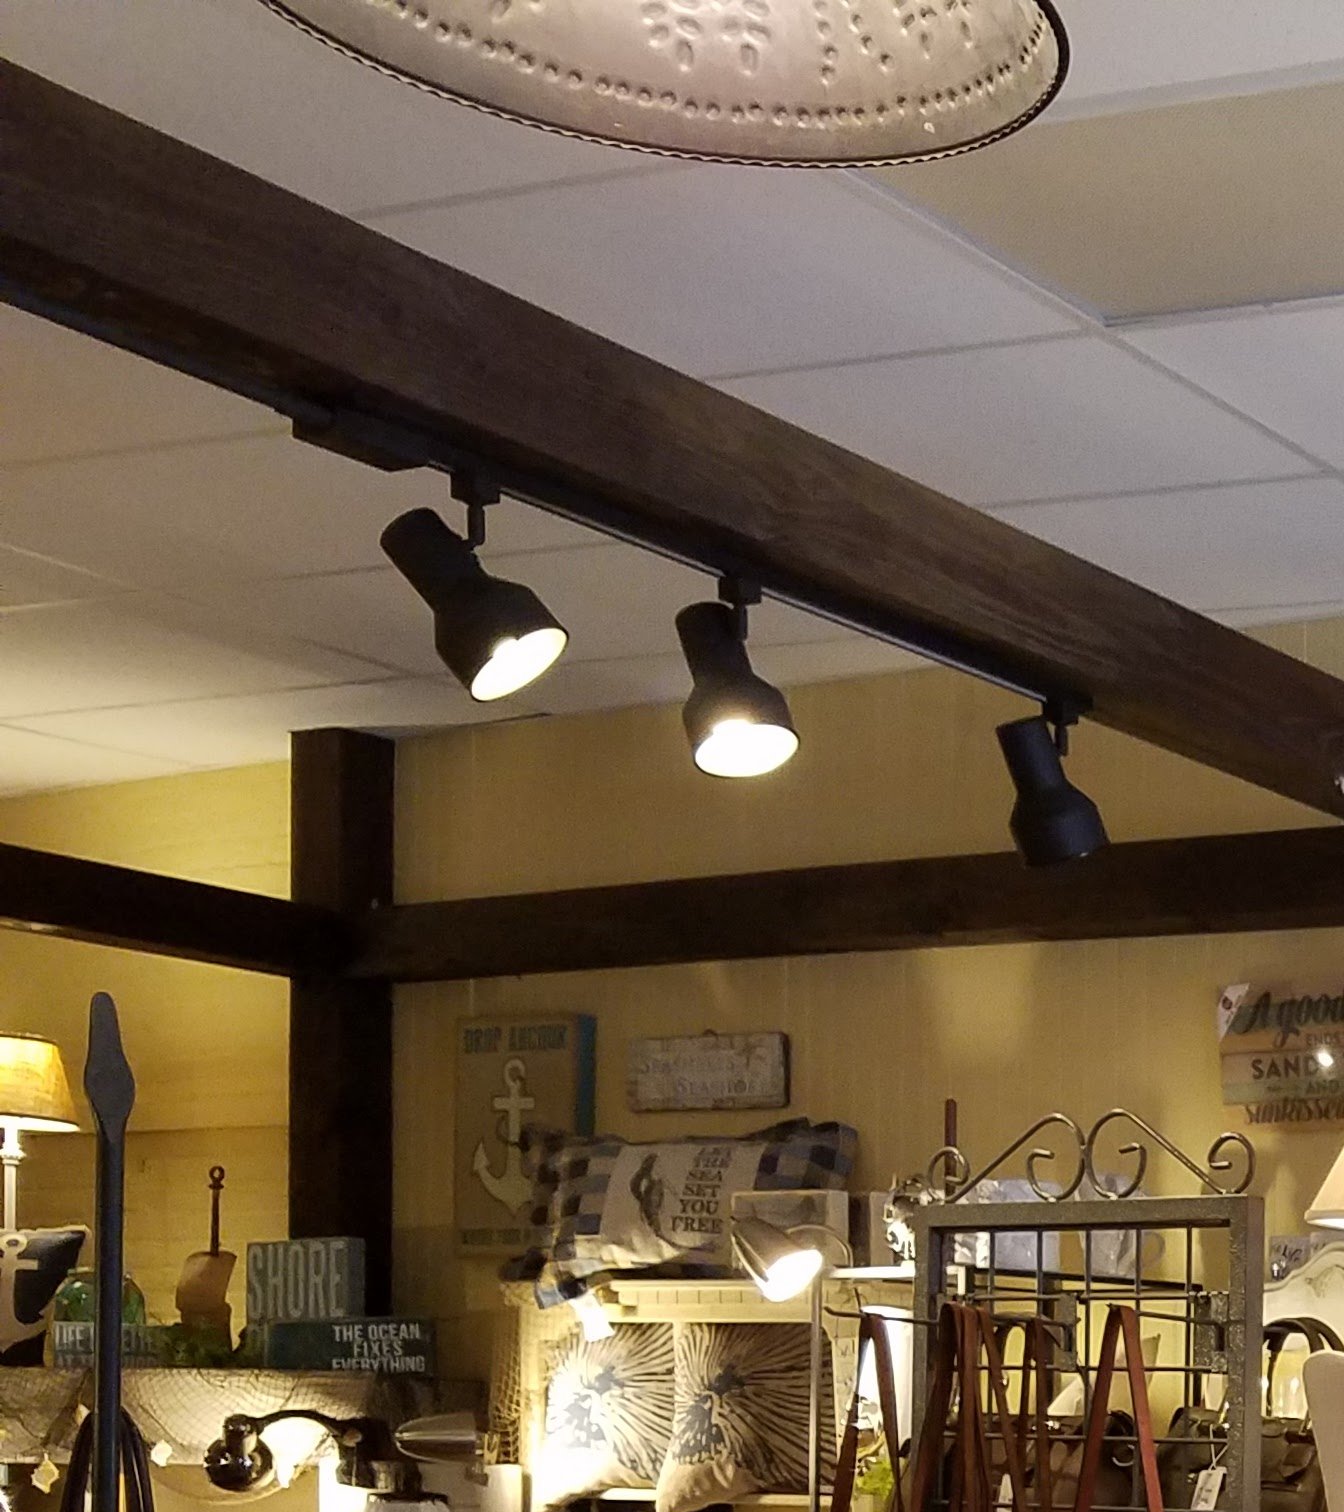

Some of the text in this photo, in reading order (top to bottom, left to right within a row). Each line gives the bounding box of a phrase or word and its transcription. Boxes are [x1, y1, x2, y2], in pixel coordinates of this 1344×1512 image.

[1252, 1050, 1331, 1080] SAND
[683, 1184, 721, 1197] SET
[680, 1199, 718, 1215] YOU
[671, 1216, 723, 1234] FREE
[248, 1240, 345, 1318] SHORE
[55, 1324, 84, 1351] LIFE
[332, 1323, 420, 1342] THE OCEAN
[354, 1340, 402, 1357] FIXES
[332, 1355, 425, 1372] EVERYTHING
